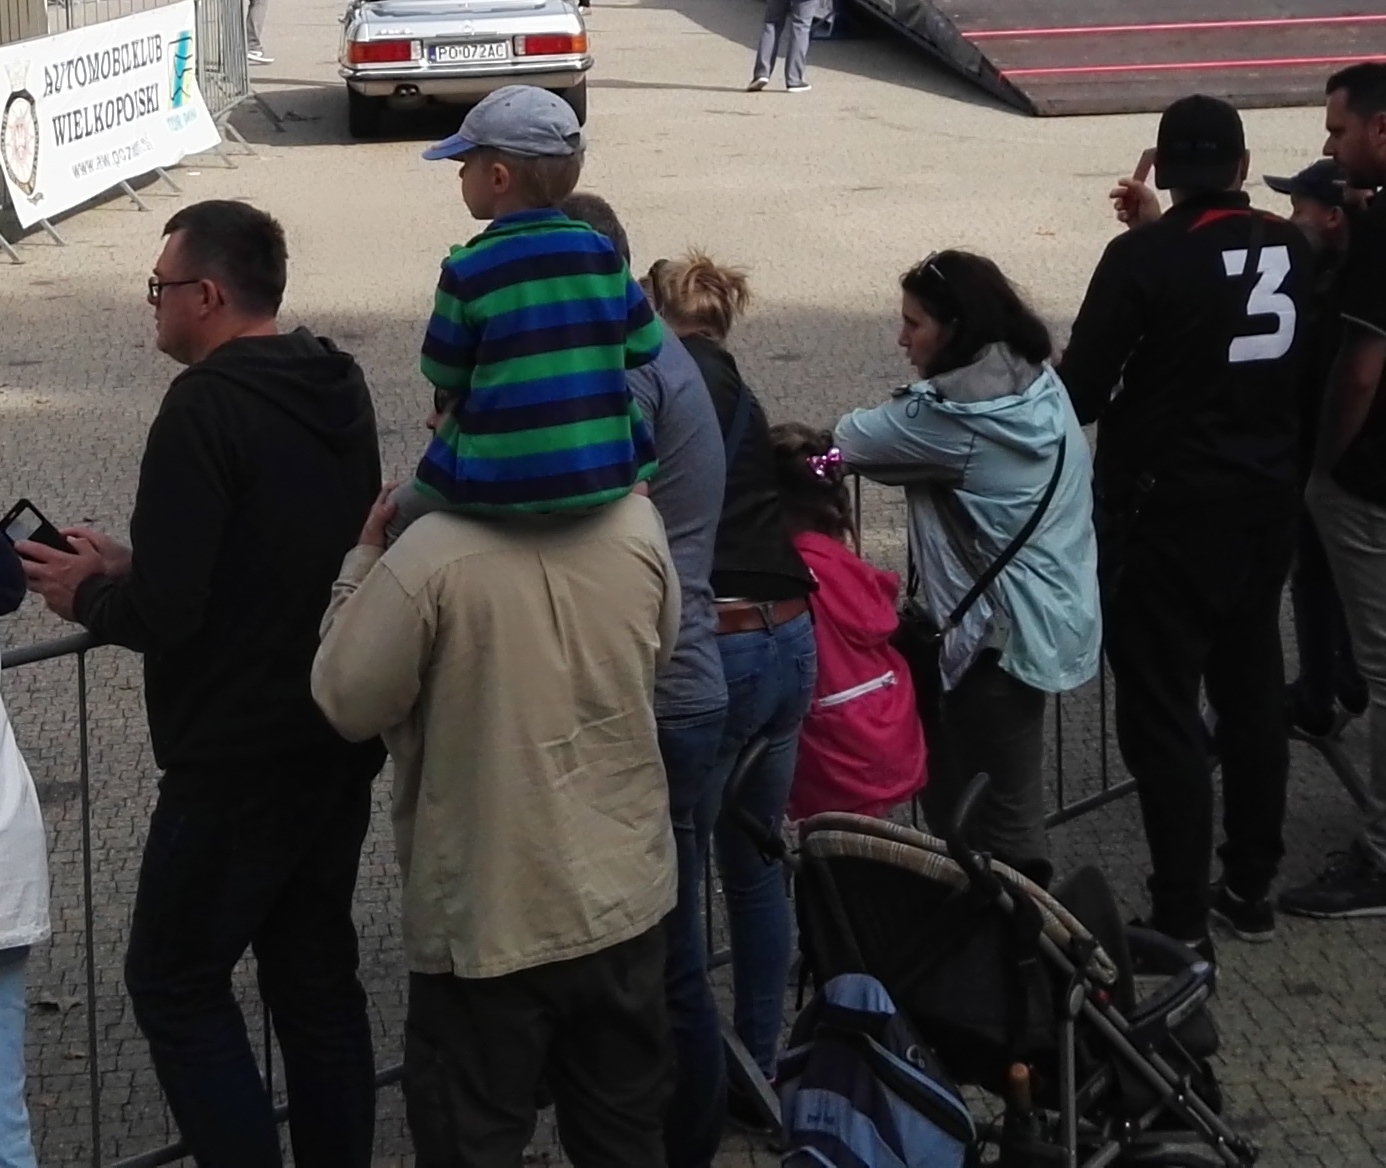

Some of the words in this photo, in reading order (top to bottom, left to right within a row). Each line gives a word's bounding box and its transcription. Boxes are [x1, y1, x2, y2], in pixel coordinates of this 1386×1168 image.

[43, 33, 163, 98] AUTOMOBILKLUB
[438, 44, 457, 61] PO
[462, 42, 505, 59] 072AC
[52, 83, 159, 147] WIELKOPOLSKI
[1221, 244, 1297, 363] 3
